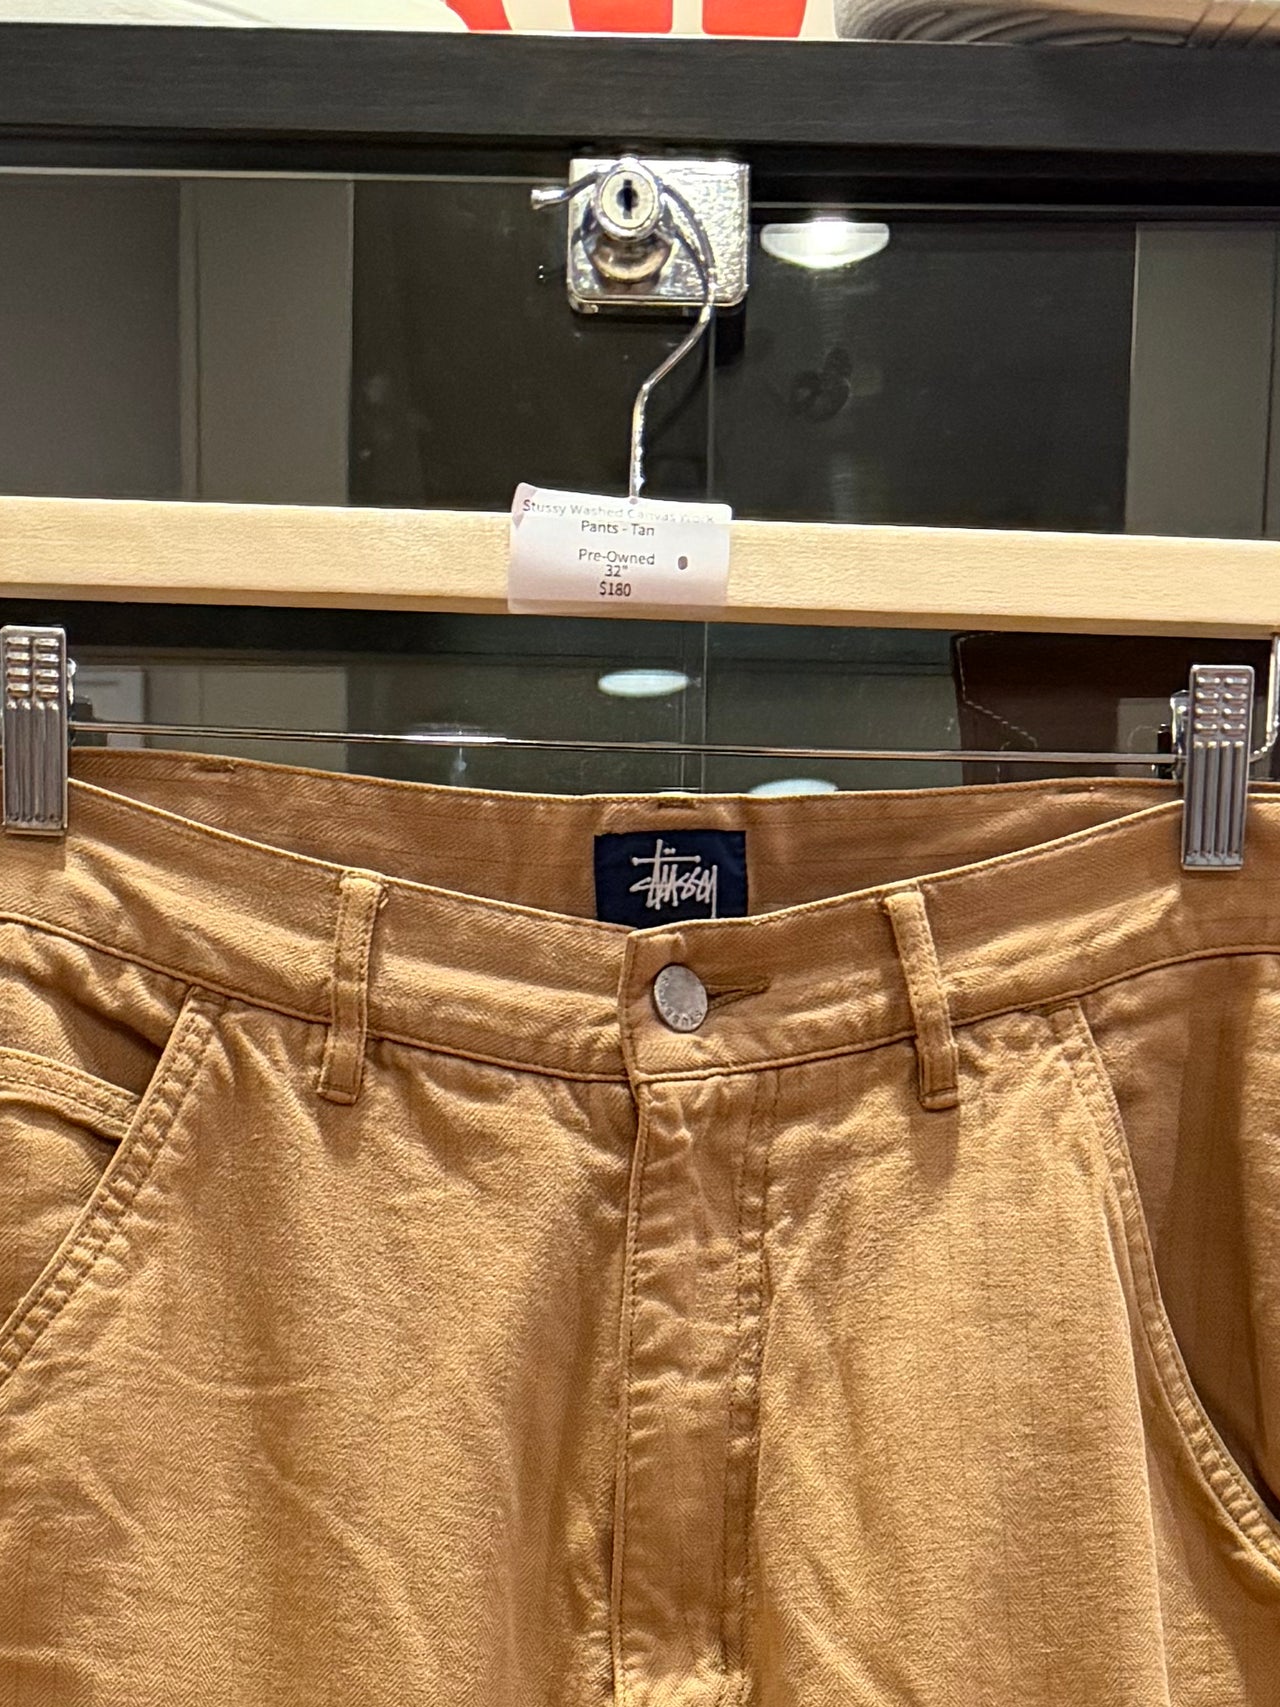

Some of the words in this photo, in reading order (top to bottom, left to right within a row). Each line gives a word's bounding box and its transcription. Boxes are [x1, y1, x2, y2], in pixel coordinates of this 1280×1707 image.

[523, 499, 567, 516] Stussy
[570, 504, 624, 518] Washed
[581, 520, 619, 534] Pants
[631, 523, 656, 537] Tan
[578, 548, 656, 566] Pre-Owned
[604, 564, 629, 577] 32"
[599, 581, 632, 598] $180
